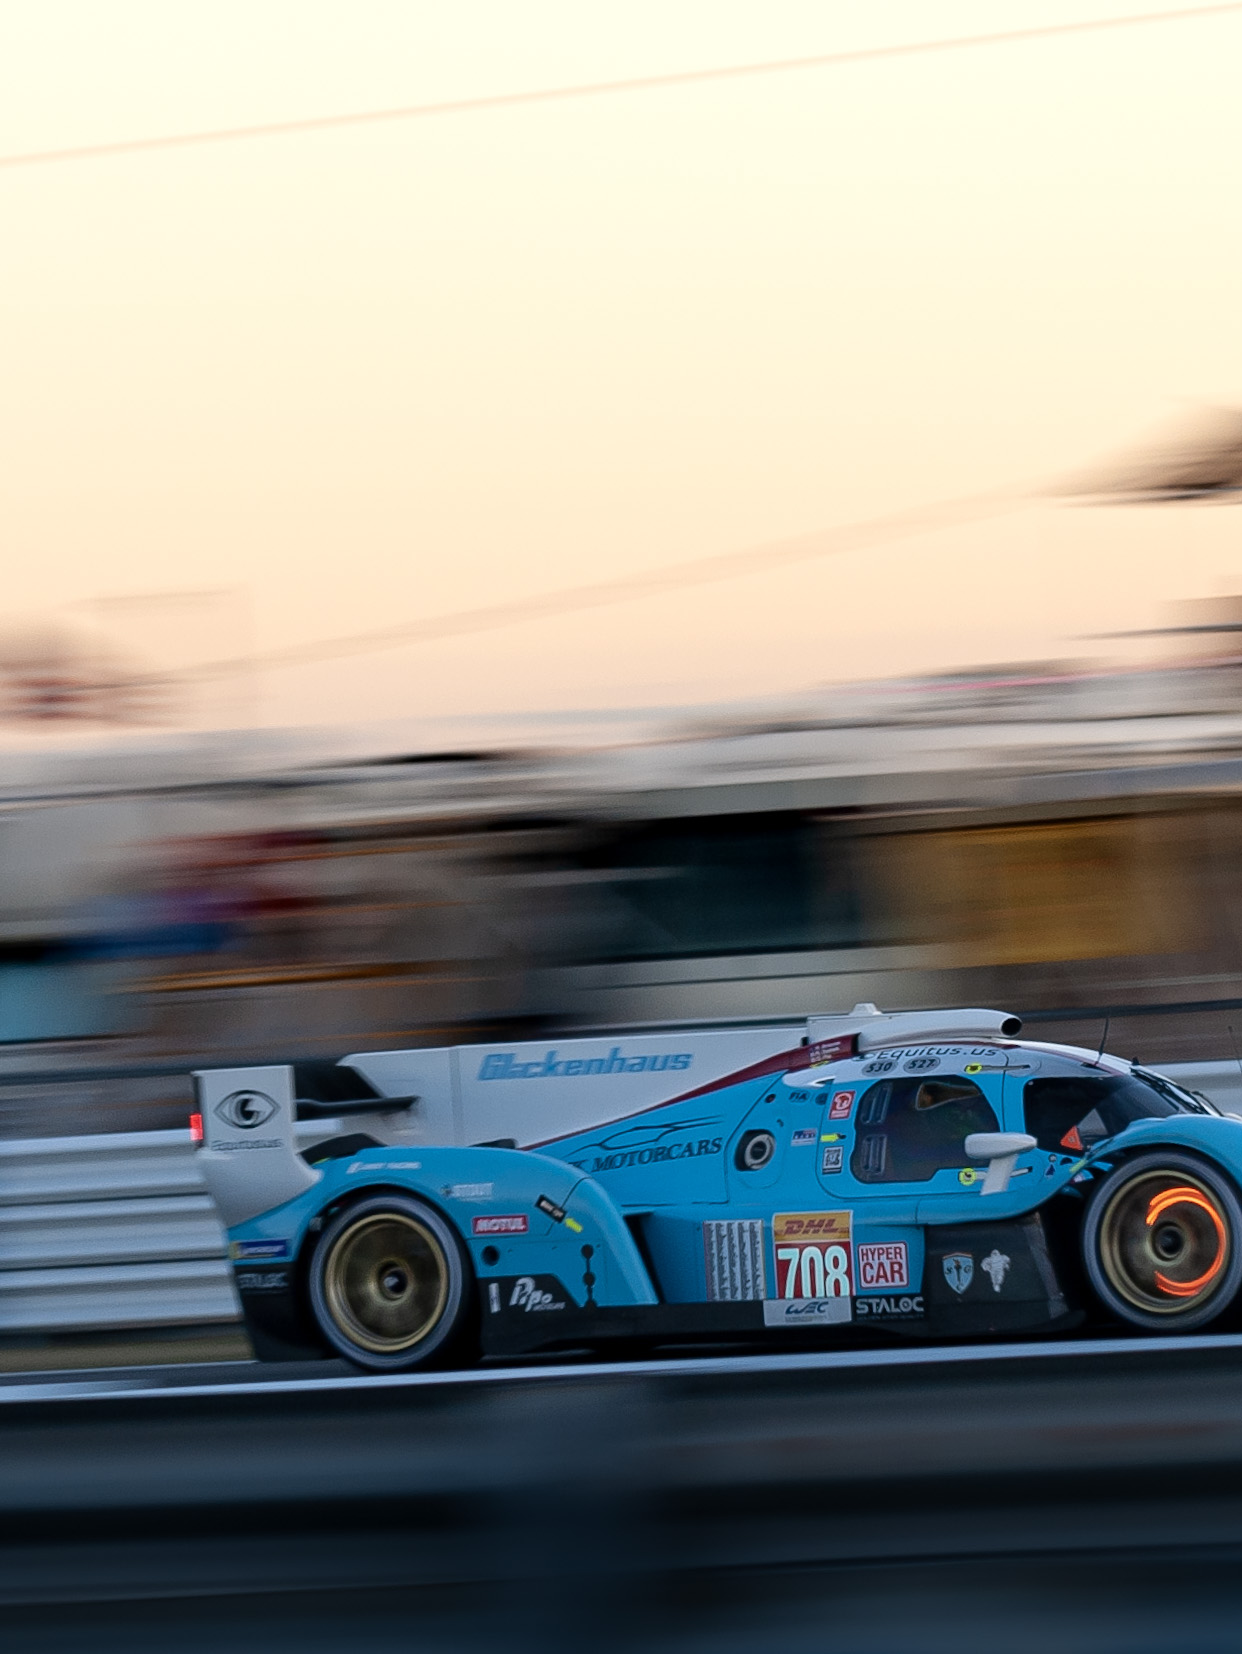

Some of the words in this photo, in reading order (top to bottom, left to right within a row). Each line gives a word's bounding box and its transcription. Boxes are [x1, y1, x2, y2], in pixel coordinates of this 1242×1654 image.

[877, 1045, 997, 1061] Equitus.us
[866, 1060, 893, 1073] 530
[908, 1058, 936, 1069] 527
[591, 1137, 723, 1173] MOTORCARS
[475, 1216, 526, 1232] MOTUL
[783, 1218, 839, 1236] DHL
[861, 1246, 903, 1262] HYPER
[777, 1244, 850, 1299] 708
[862, 1261, 905, 1284] CAR
[785, 1301, 829, 1315] WEC
[855, 1296, 924, 1315] STALOC
